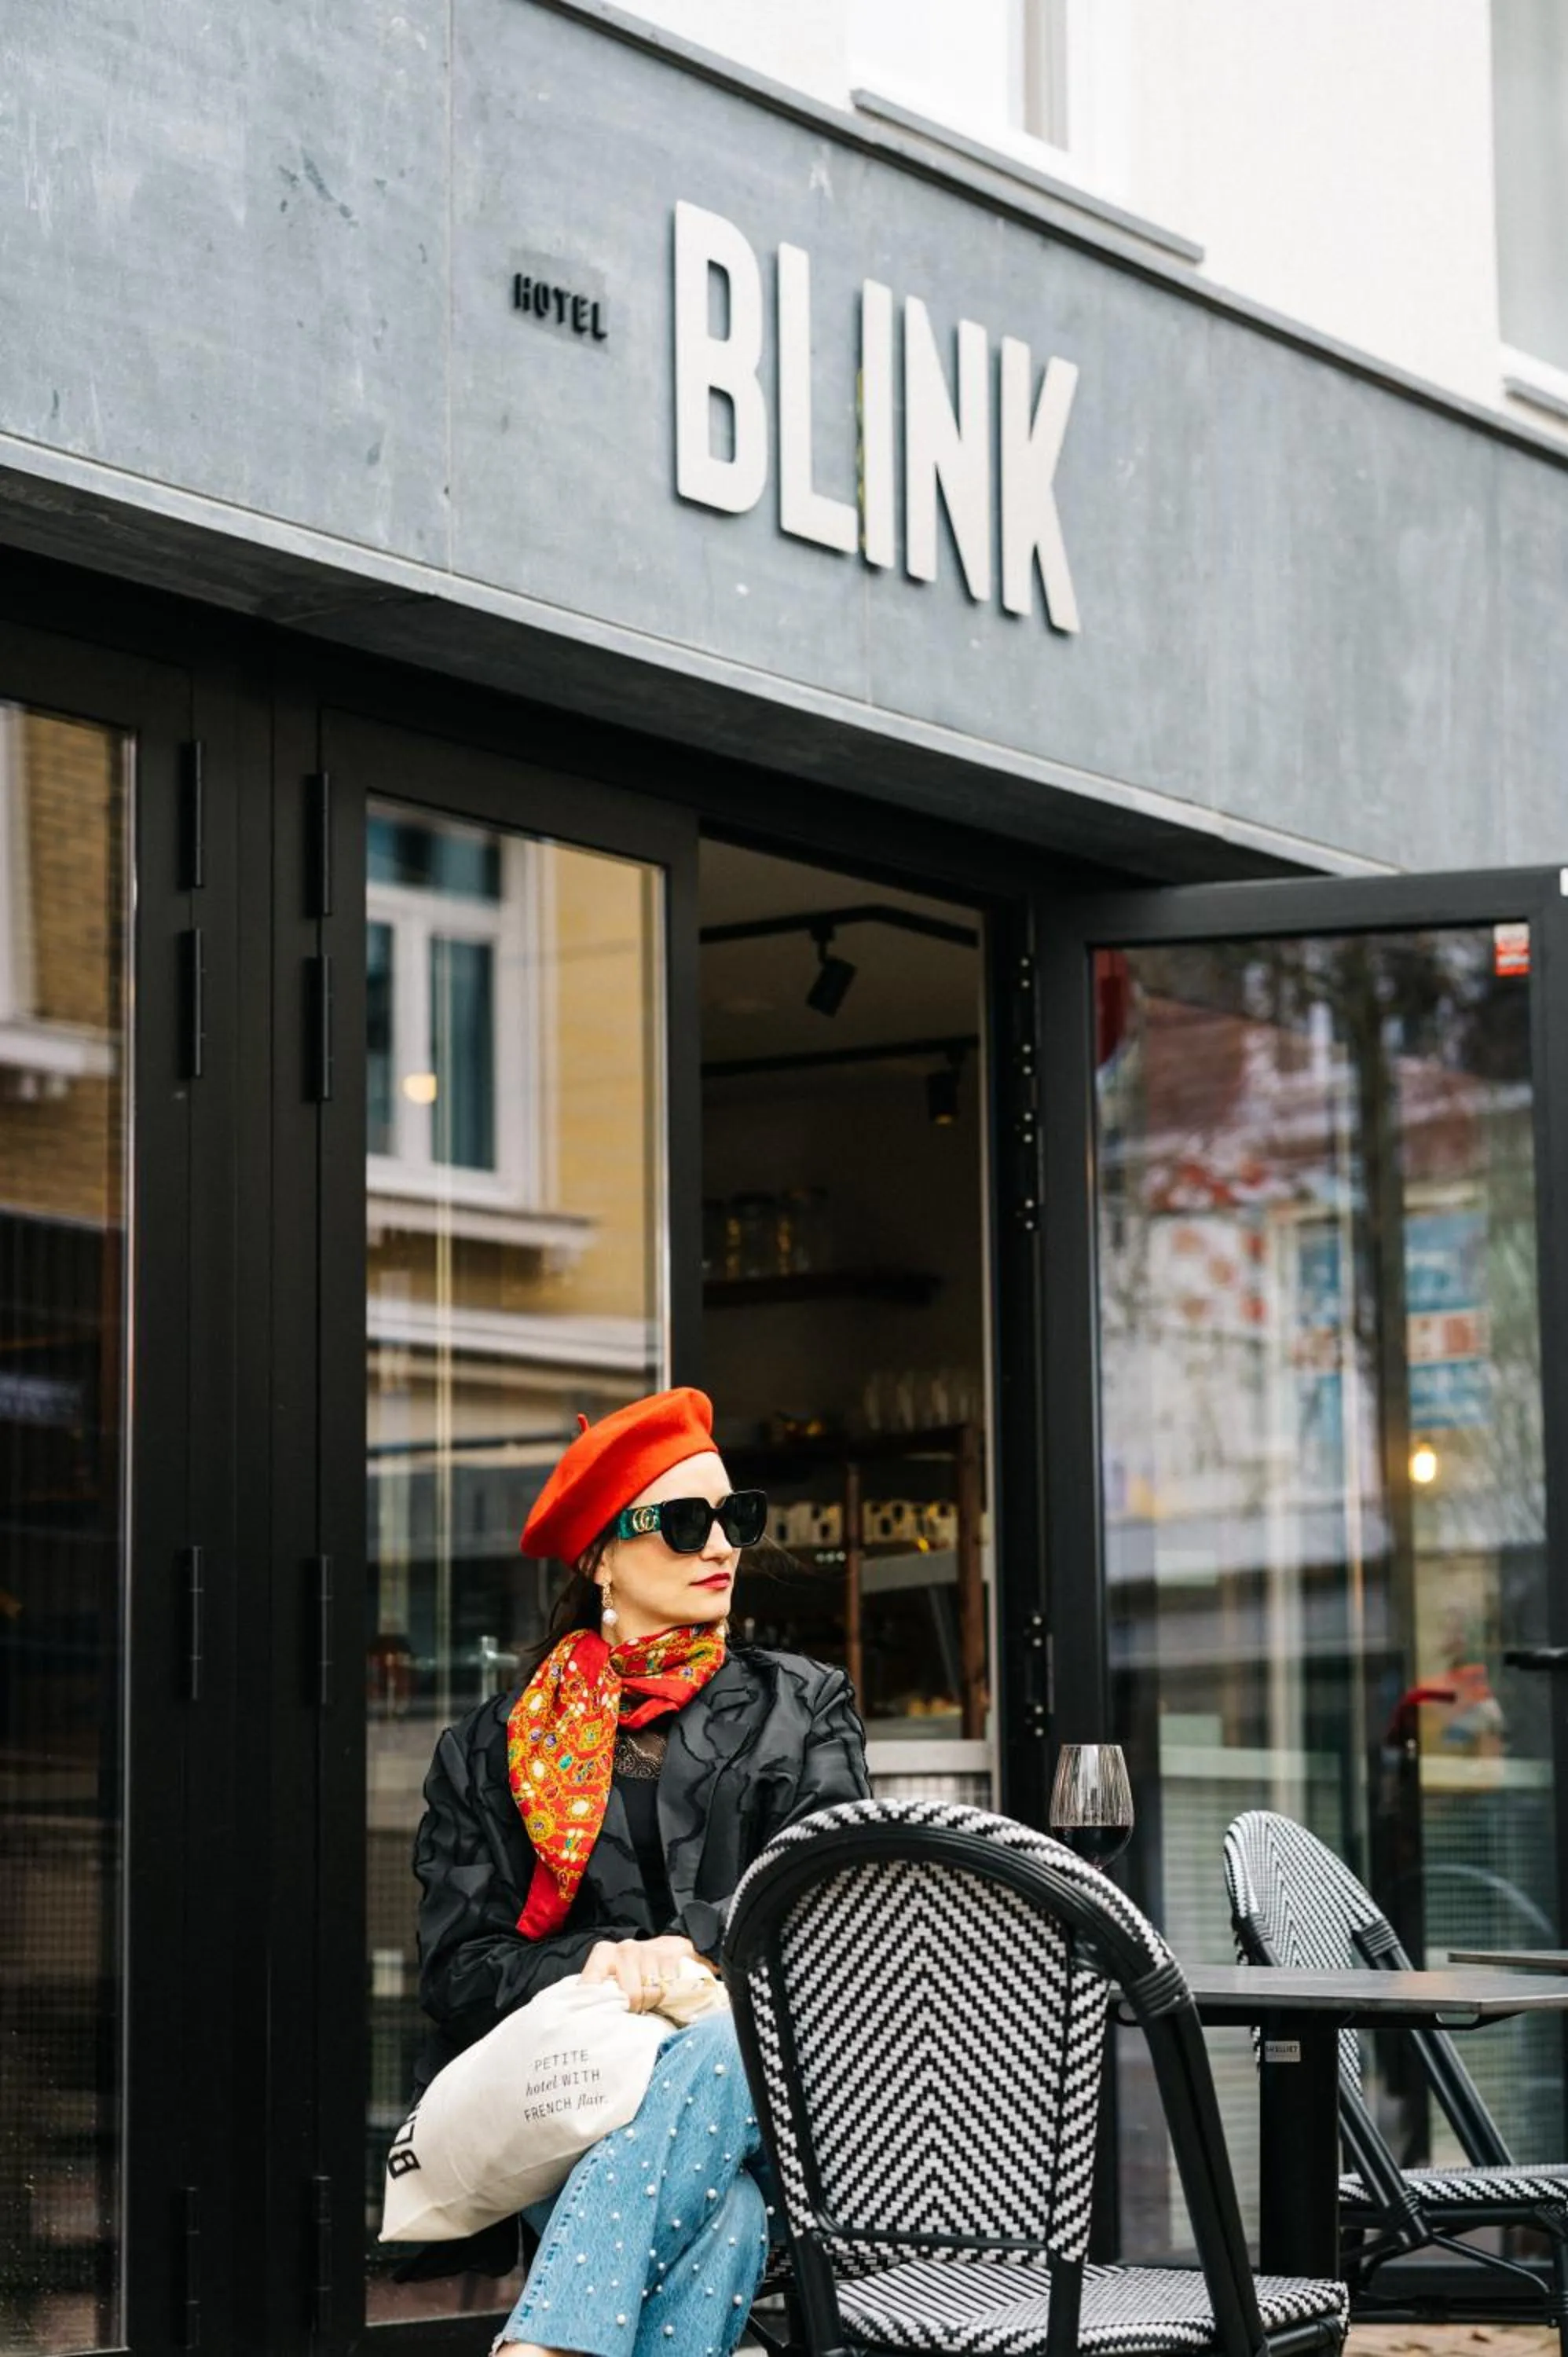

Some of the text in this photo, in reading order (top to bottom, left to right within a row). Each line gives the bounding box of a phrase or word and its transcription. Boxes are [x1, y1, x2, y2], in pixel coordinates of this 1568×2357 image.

[514, 200, 1080, 634] HOTEL BLINK
[534, 2048, 588, 2072] PETITE
[526, 2068, 600, 2097] hotel WITH
[523, 2096, 572, 2123] FRENCH
